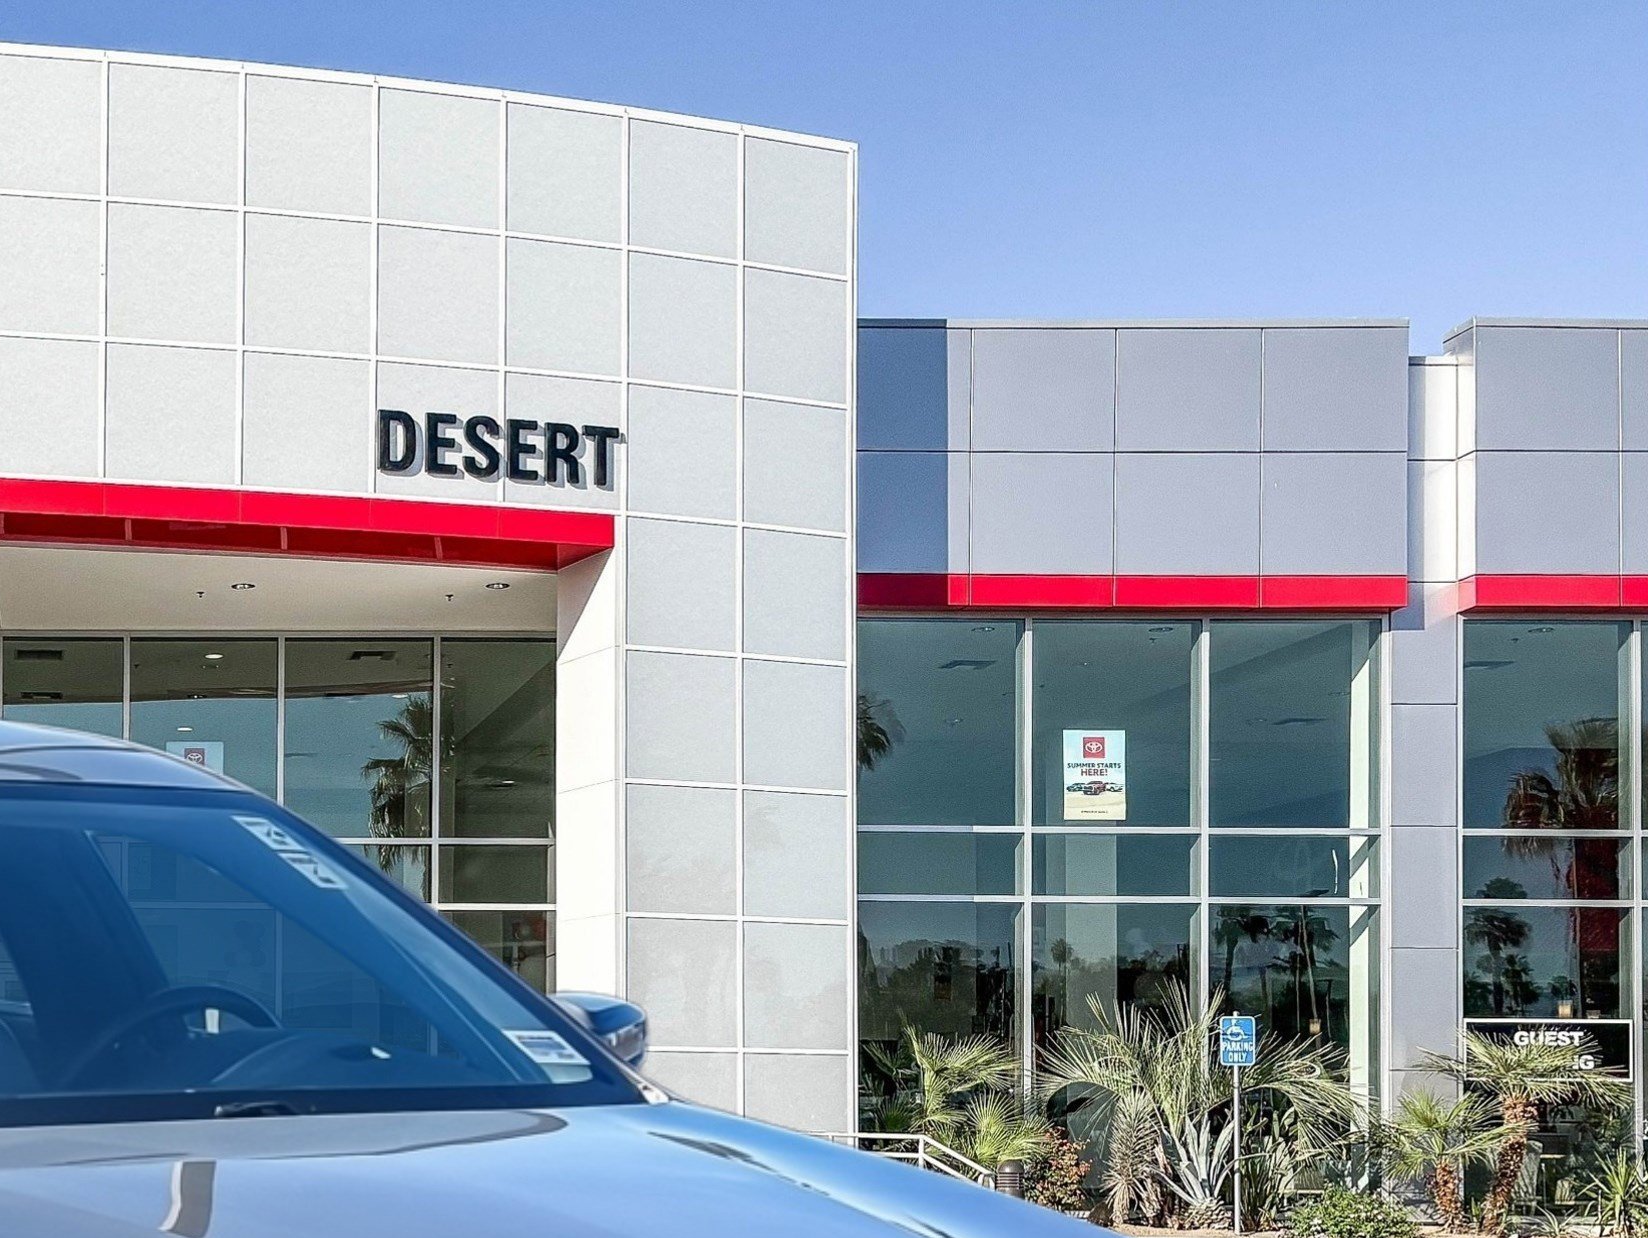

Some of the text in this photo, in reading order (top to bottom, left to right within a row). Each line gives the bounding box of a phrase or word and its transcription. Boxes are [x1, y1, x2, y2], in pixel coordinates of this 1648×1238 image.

[377, 409, 620, 486] DESERT
[1514, 1031, 1584, 1046] GUEST
[1222, 1041, 1253, 1052] PARKING
[1228, 1051, 1247, 1062] ONLY
